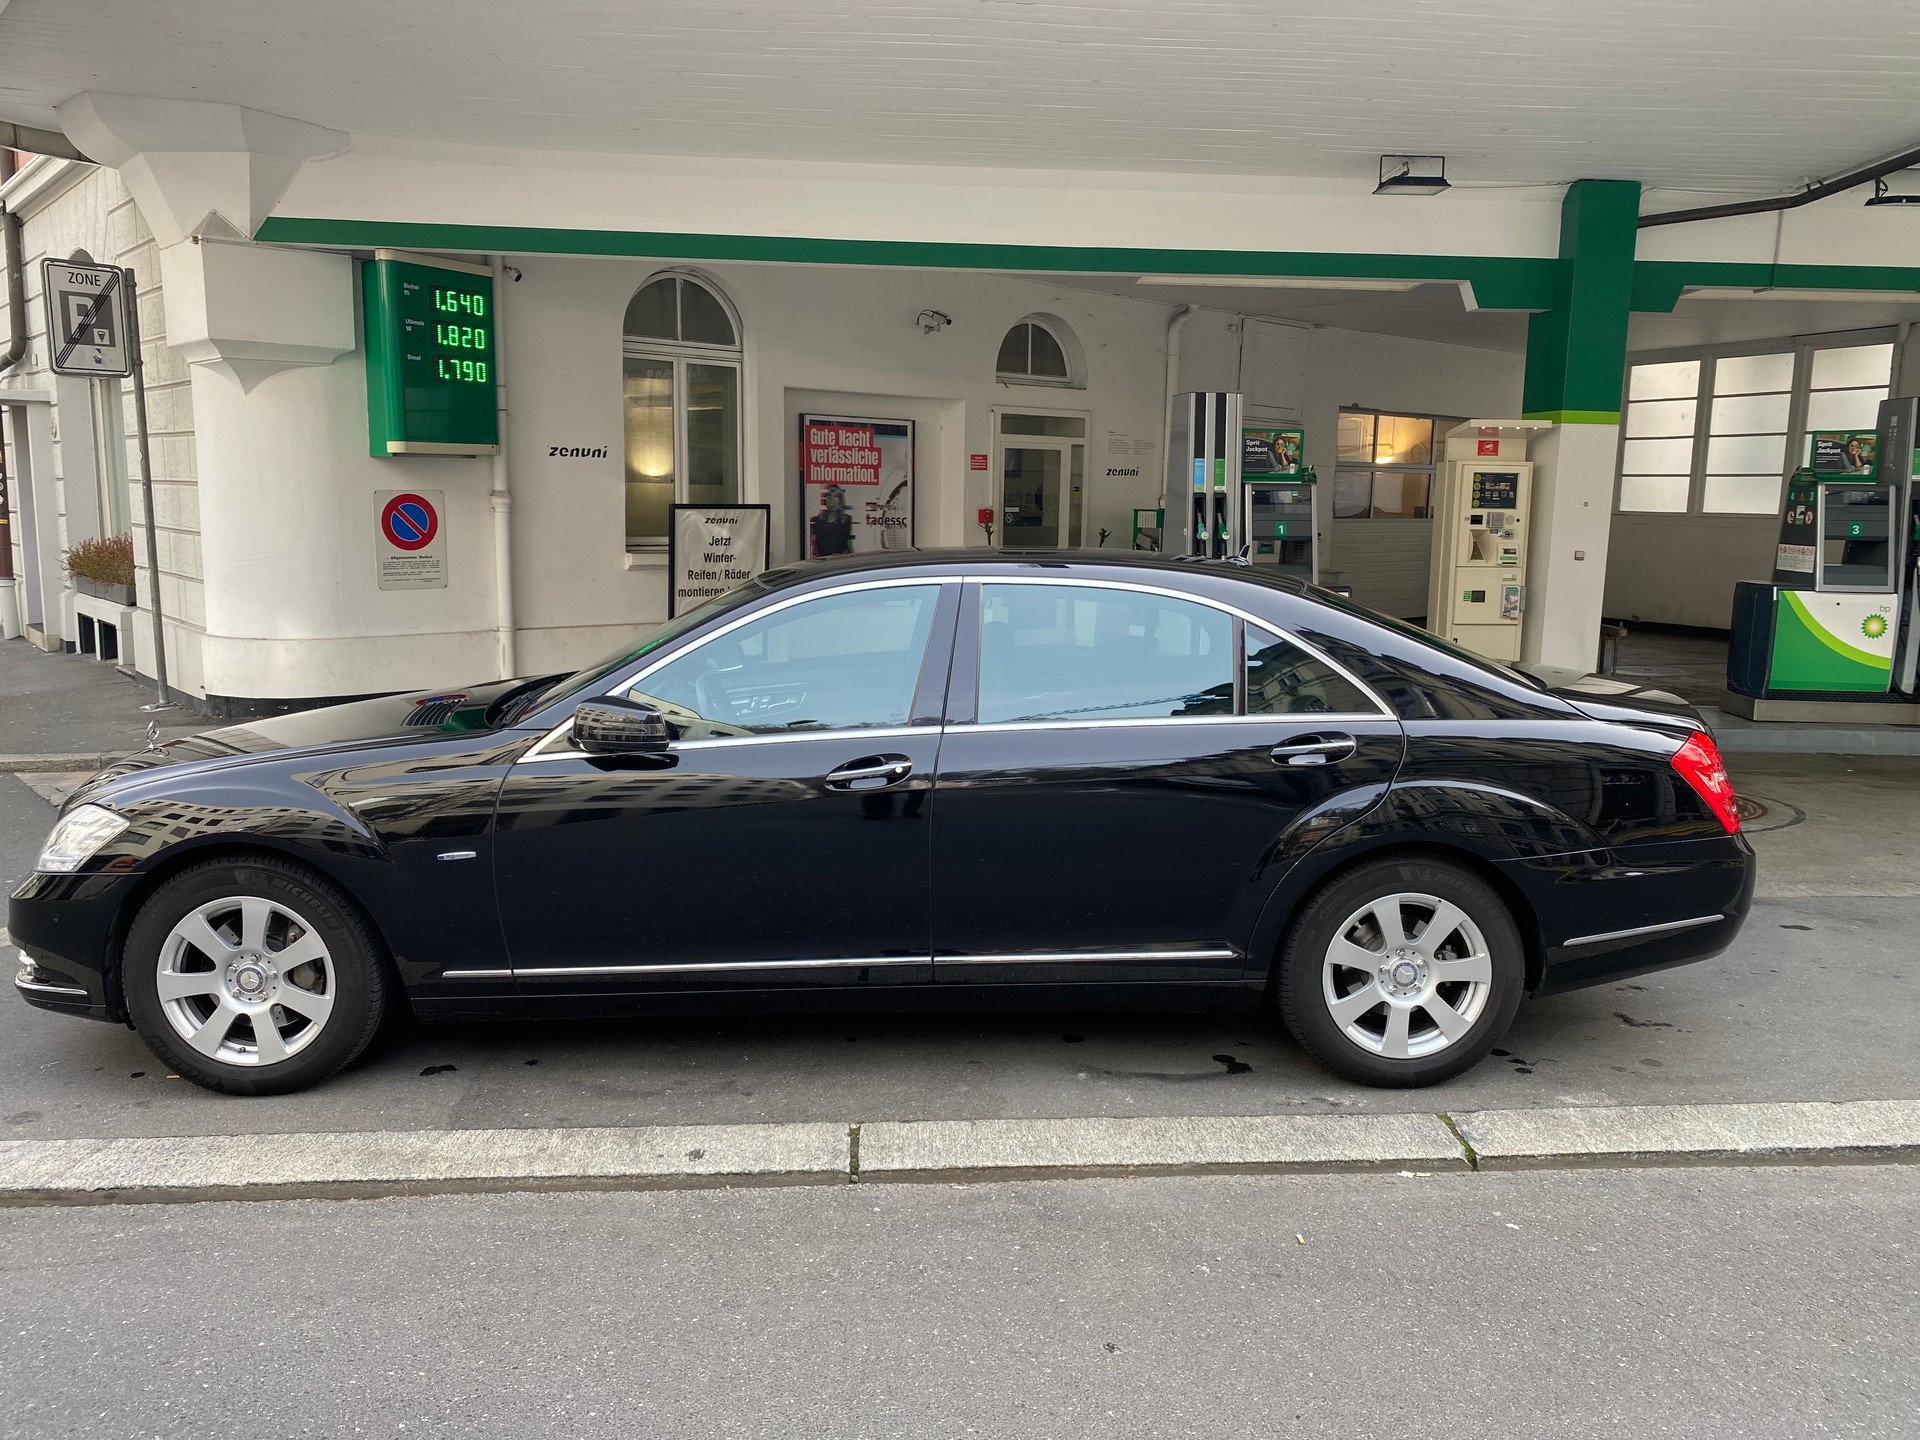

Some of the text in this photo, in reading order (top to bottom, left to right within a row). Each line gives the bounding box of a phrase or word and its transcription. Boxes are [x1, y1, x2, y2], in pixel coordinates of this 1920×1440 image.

[68, 271, 101, 286] ZONE
[435, 289, 484, 316] 1.640
[437, 324, 485, 349] 1.820
[439, 359, 487, 383] 1.790
[810, 428, 870, 449] Gute Nacht
[549, 445, 609, 458] zenuni
[810, 446, 879, 465] verlässliche
[810, 464, 878, 483] Information.
[1106, 467, 1139, 477] zenuni
[705, 516, 739, 524] zenuni
[1278, 525, 1284, 534] 1
[1852, 525, 1860, 535] 3
[709, 536, 731, 546] Jetzt
[704, 552, 737, 563] Winter-
[688, 569, 717, 580] Reifen
[724, 568, 751, 579] Räder
[1880, 605, 1891, 613] bp
[271, 878, 340, 928] MICHELIN
